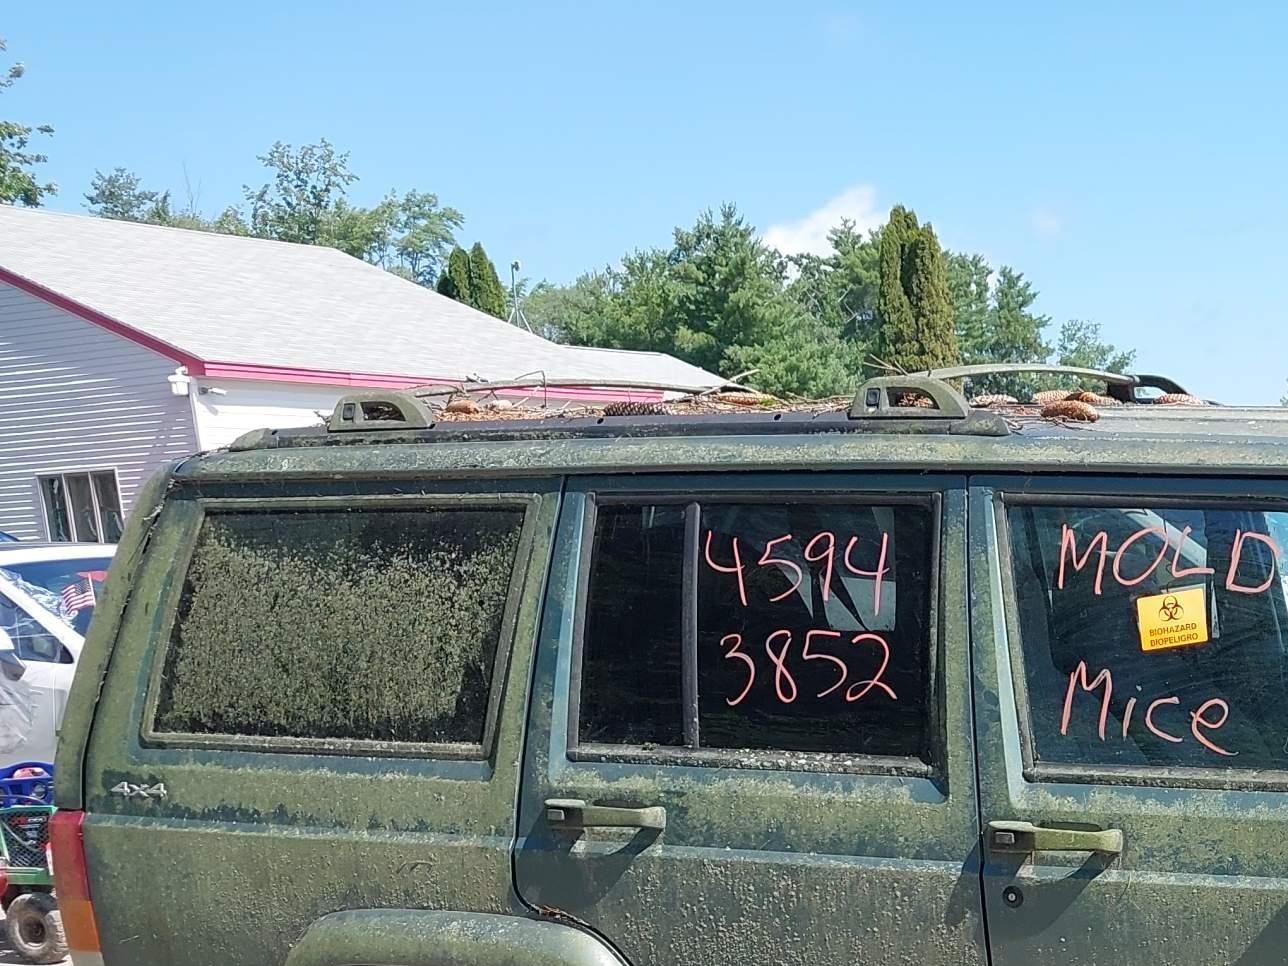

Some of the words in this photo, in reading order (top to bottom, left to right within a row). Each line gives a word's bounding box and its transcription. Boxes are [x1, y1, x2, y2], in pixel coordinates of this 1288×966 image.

[704, 530, 891, 616] 4594
[1057, 523, 1282, 595] MOLD
[1149, 622, 1198, 637] BIOHAZARD
[1150, 632, 1199, 647] BIOPELIGRO
[720, 629, 898, 706] 3852
[1059, 660, 1240, 757] Mice
